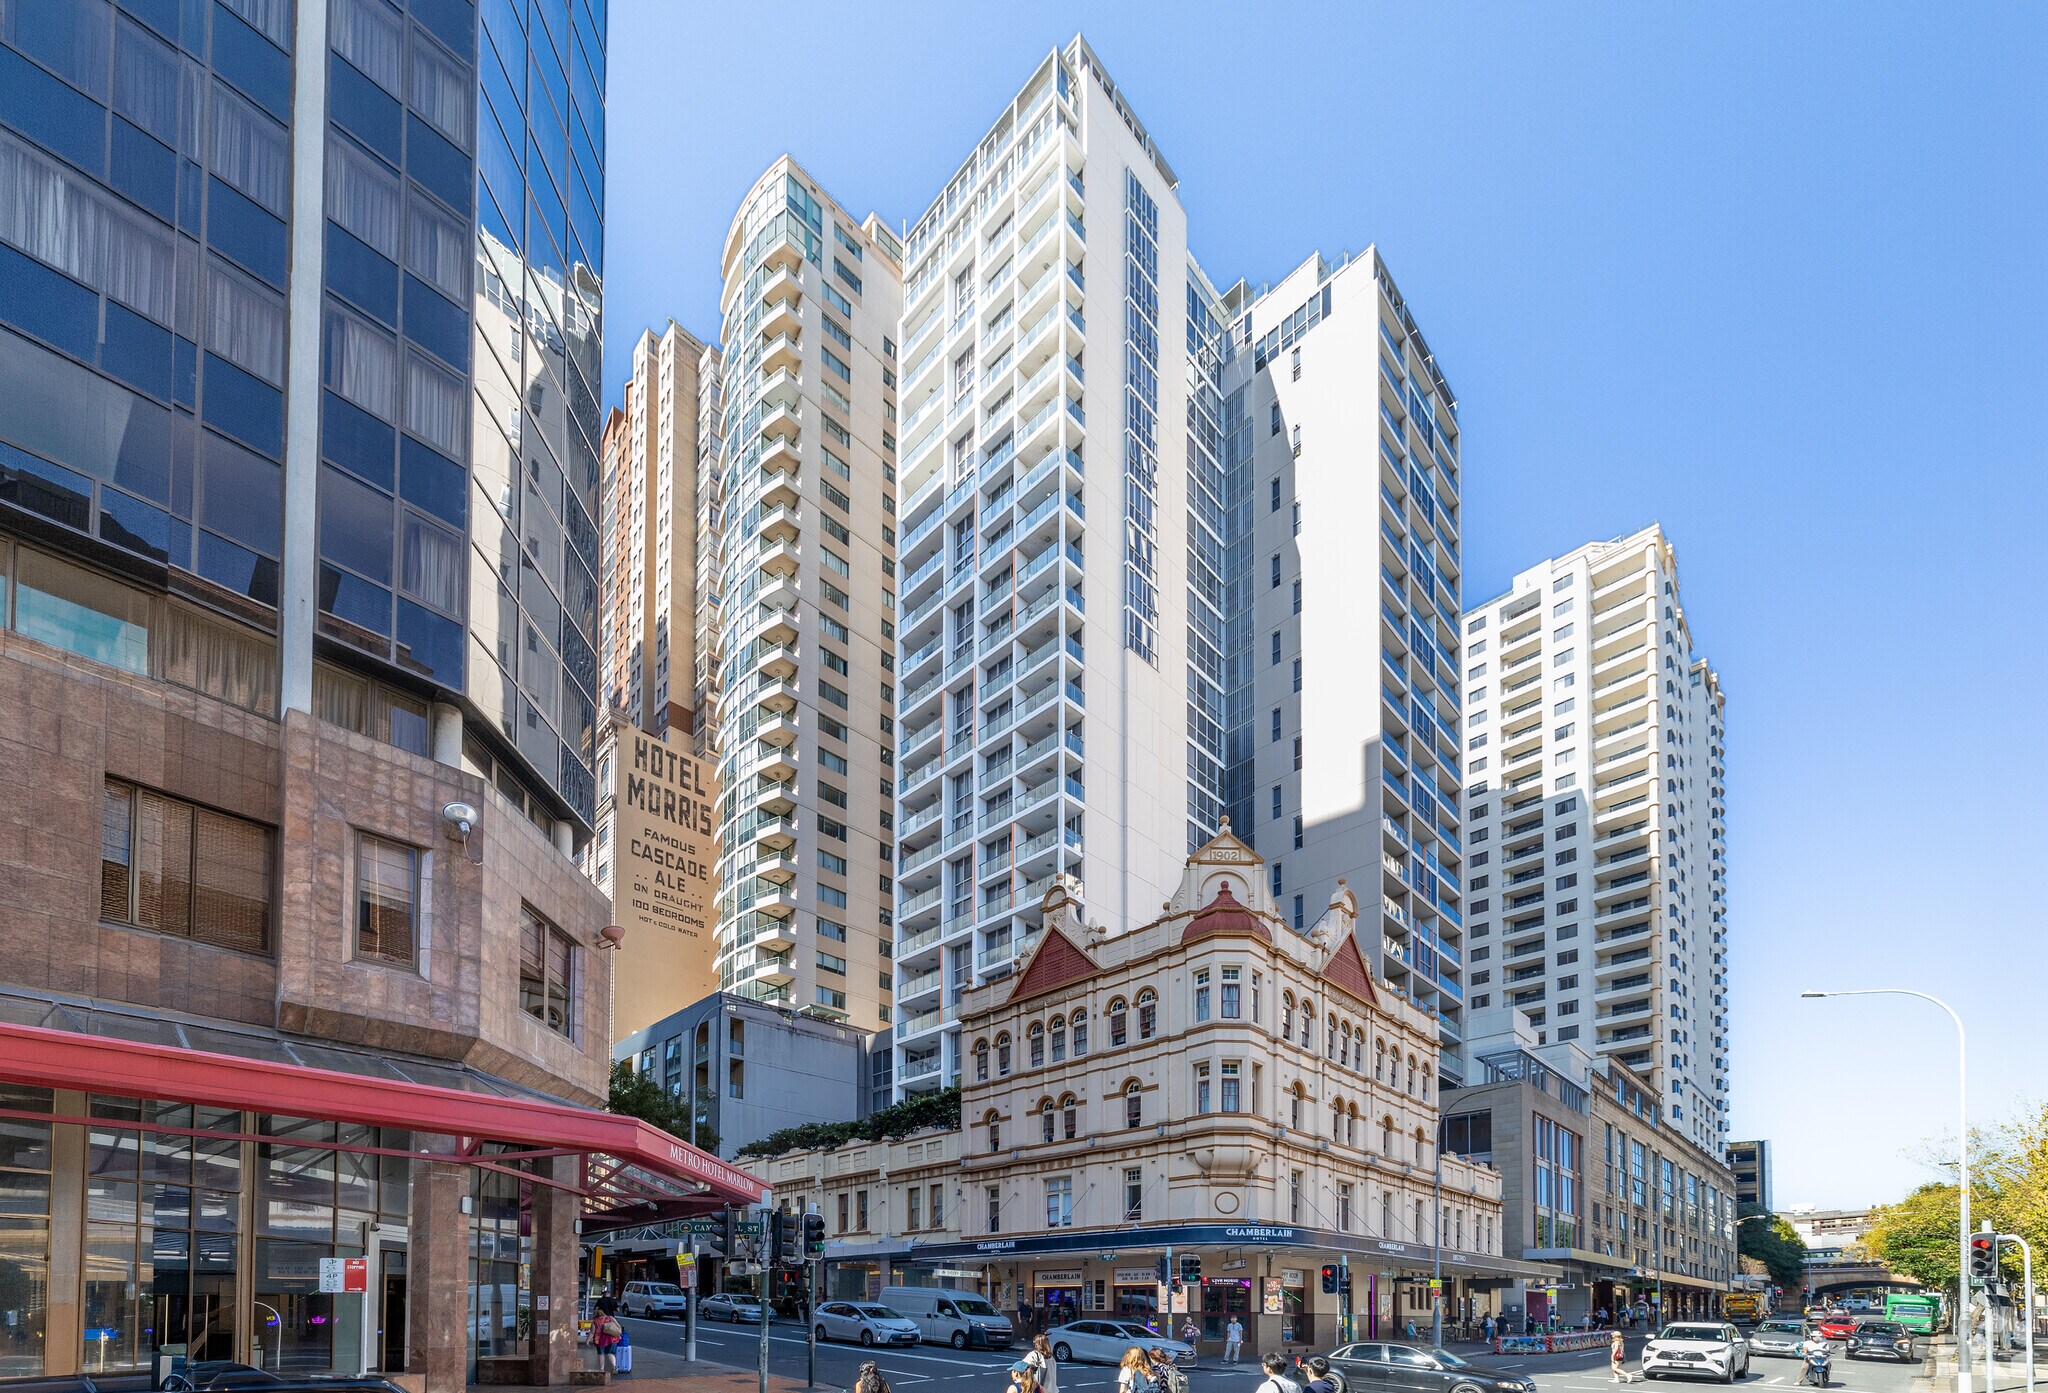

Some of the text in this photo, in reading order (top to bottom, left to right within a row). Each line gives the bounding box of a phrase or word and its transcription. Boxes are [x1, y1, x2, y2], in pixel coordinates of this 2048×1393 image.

[635, 736, 706, 797] HOTEL
[628, 772, 711, 836] MORRIS
[644, 828, 695, 855] FAMOUS
[1212, 851, 1237, 860] 1902
[631, 839, 707, 880] CASCADE
[655, 870, 685, 893] ALE
[634, 882, 703, 912] ON DRAUGHT
[632, 899, 704, 928] 100 BEDROOMS
[639, 915, 652, 924] HOT
[658, 922, 675, 931] COLD
[677, 928, 698, 938] WATER
[670, 1143, 754, 1192] METRO HOTEL MARLOW
[977, 1242, 1015, 1250] CHAMBERLAIN
[1226, 1228, 1292, 1237] CHAMBERLAIN
